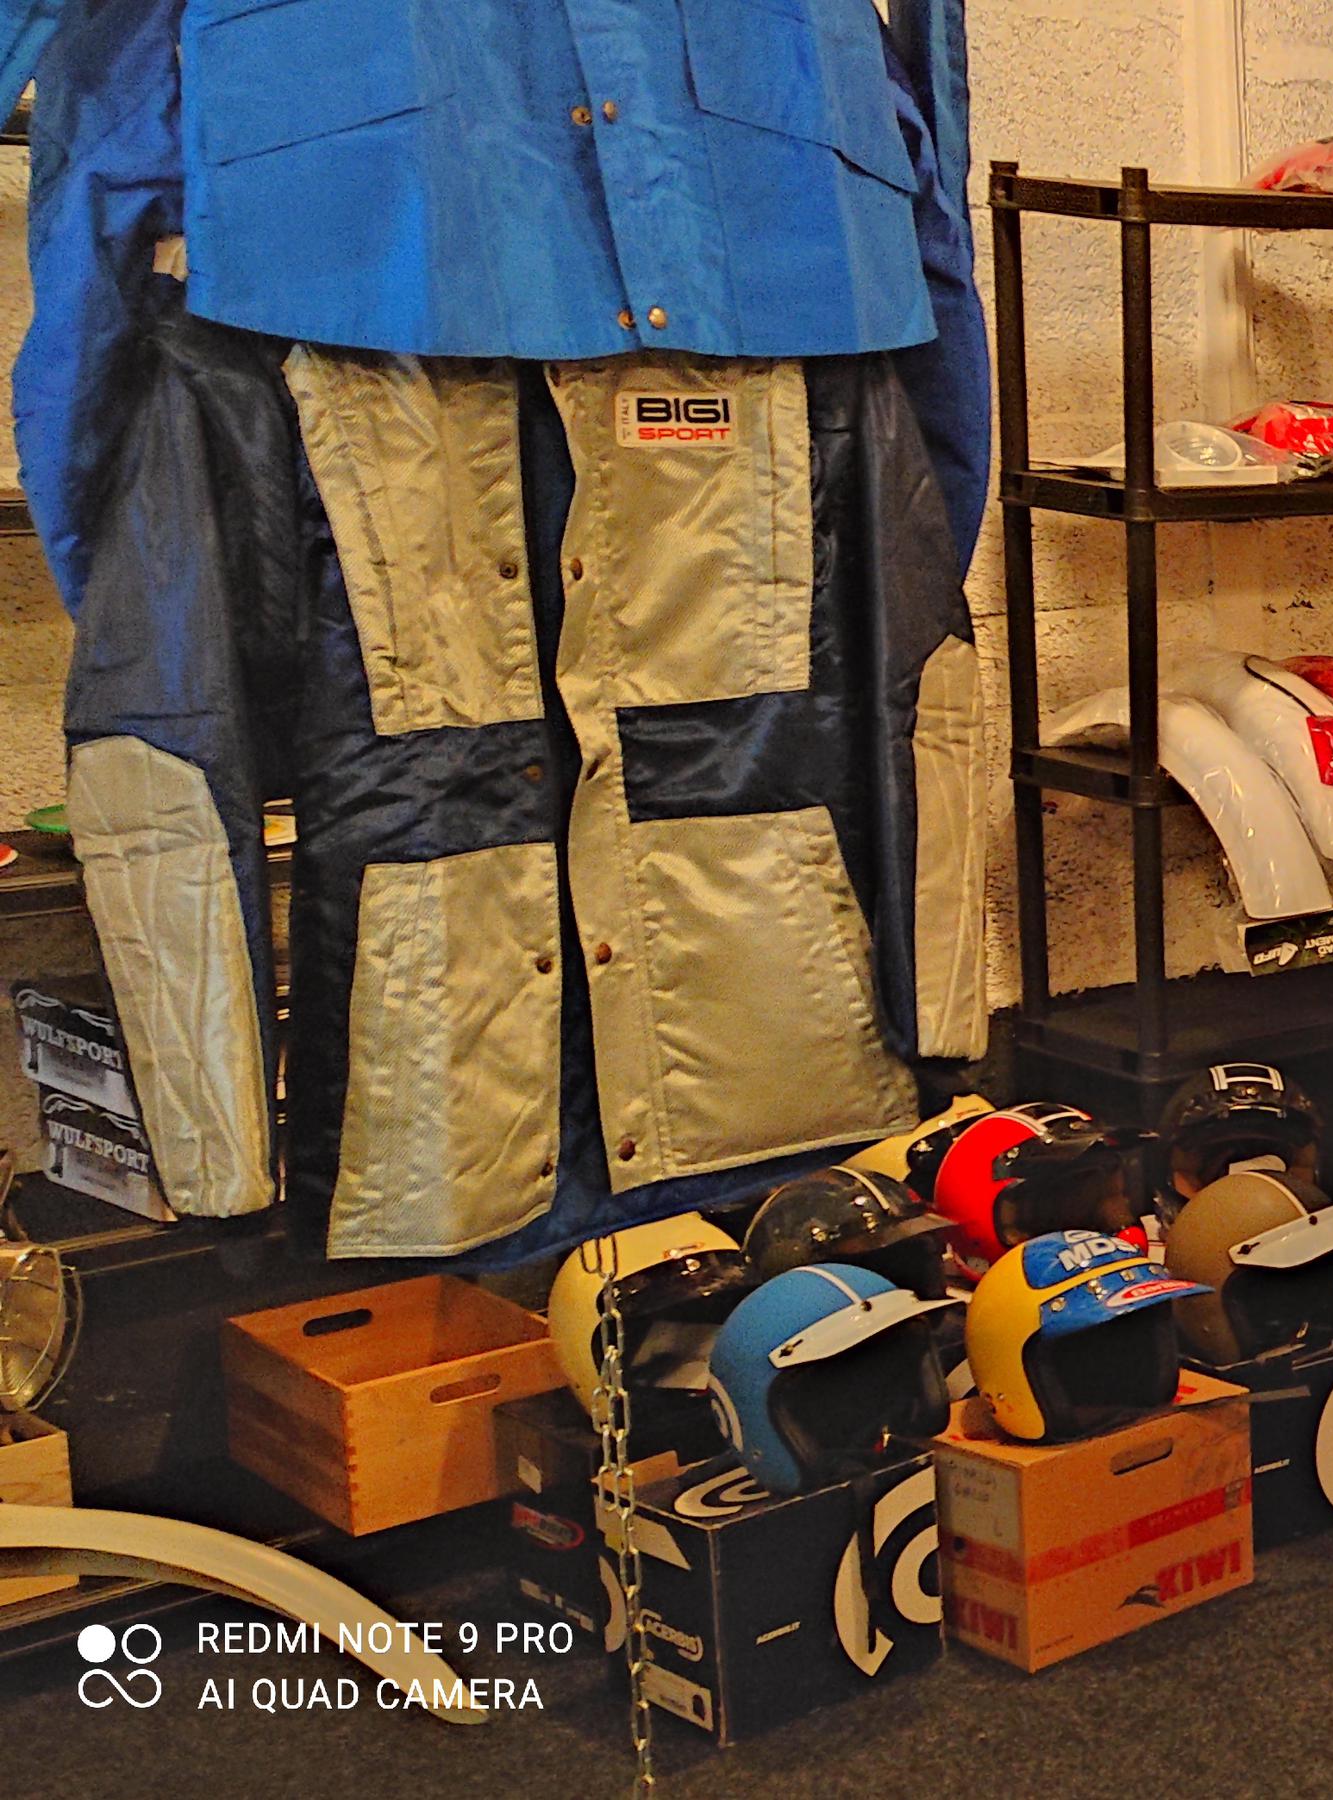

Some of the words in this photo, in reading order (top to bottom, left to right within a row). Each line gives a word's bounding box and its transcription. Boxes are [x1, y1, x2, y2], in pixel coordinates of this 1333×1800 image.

[637, 397, 730, 423] BIGI
[638, 427, 731, 440] SPORT
[46, 1119, 150, 1173] WULFSPORT
[1155, 1541, 1241, 1603] KIWI
